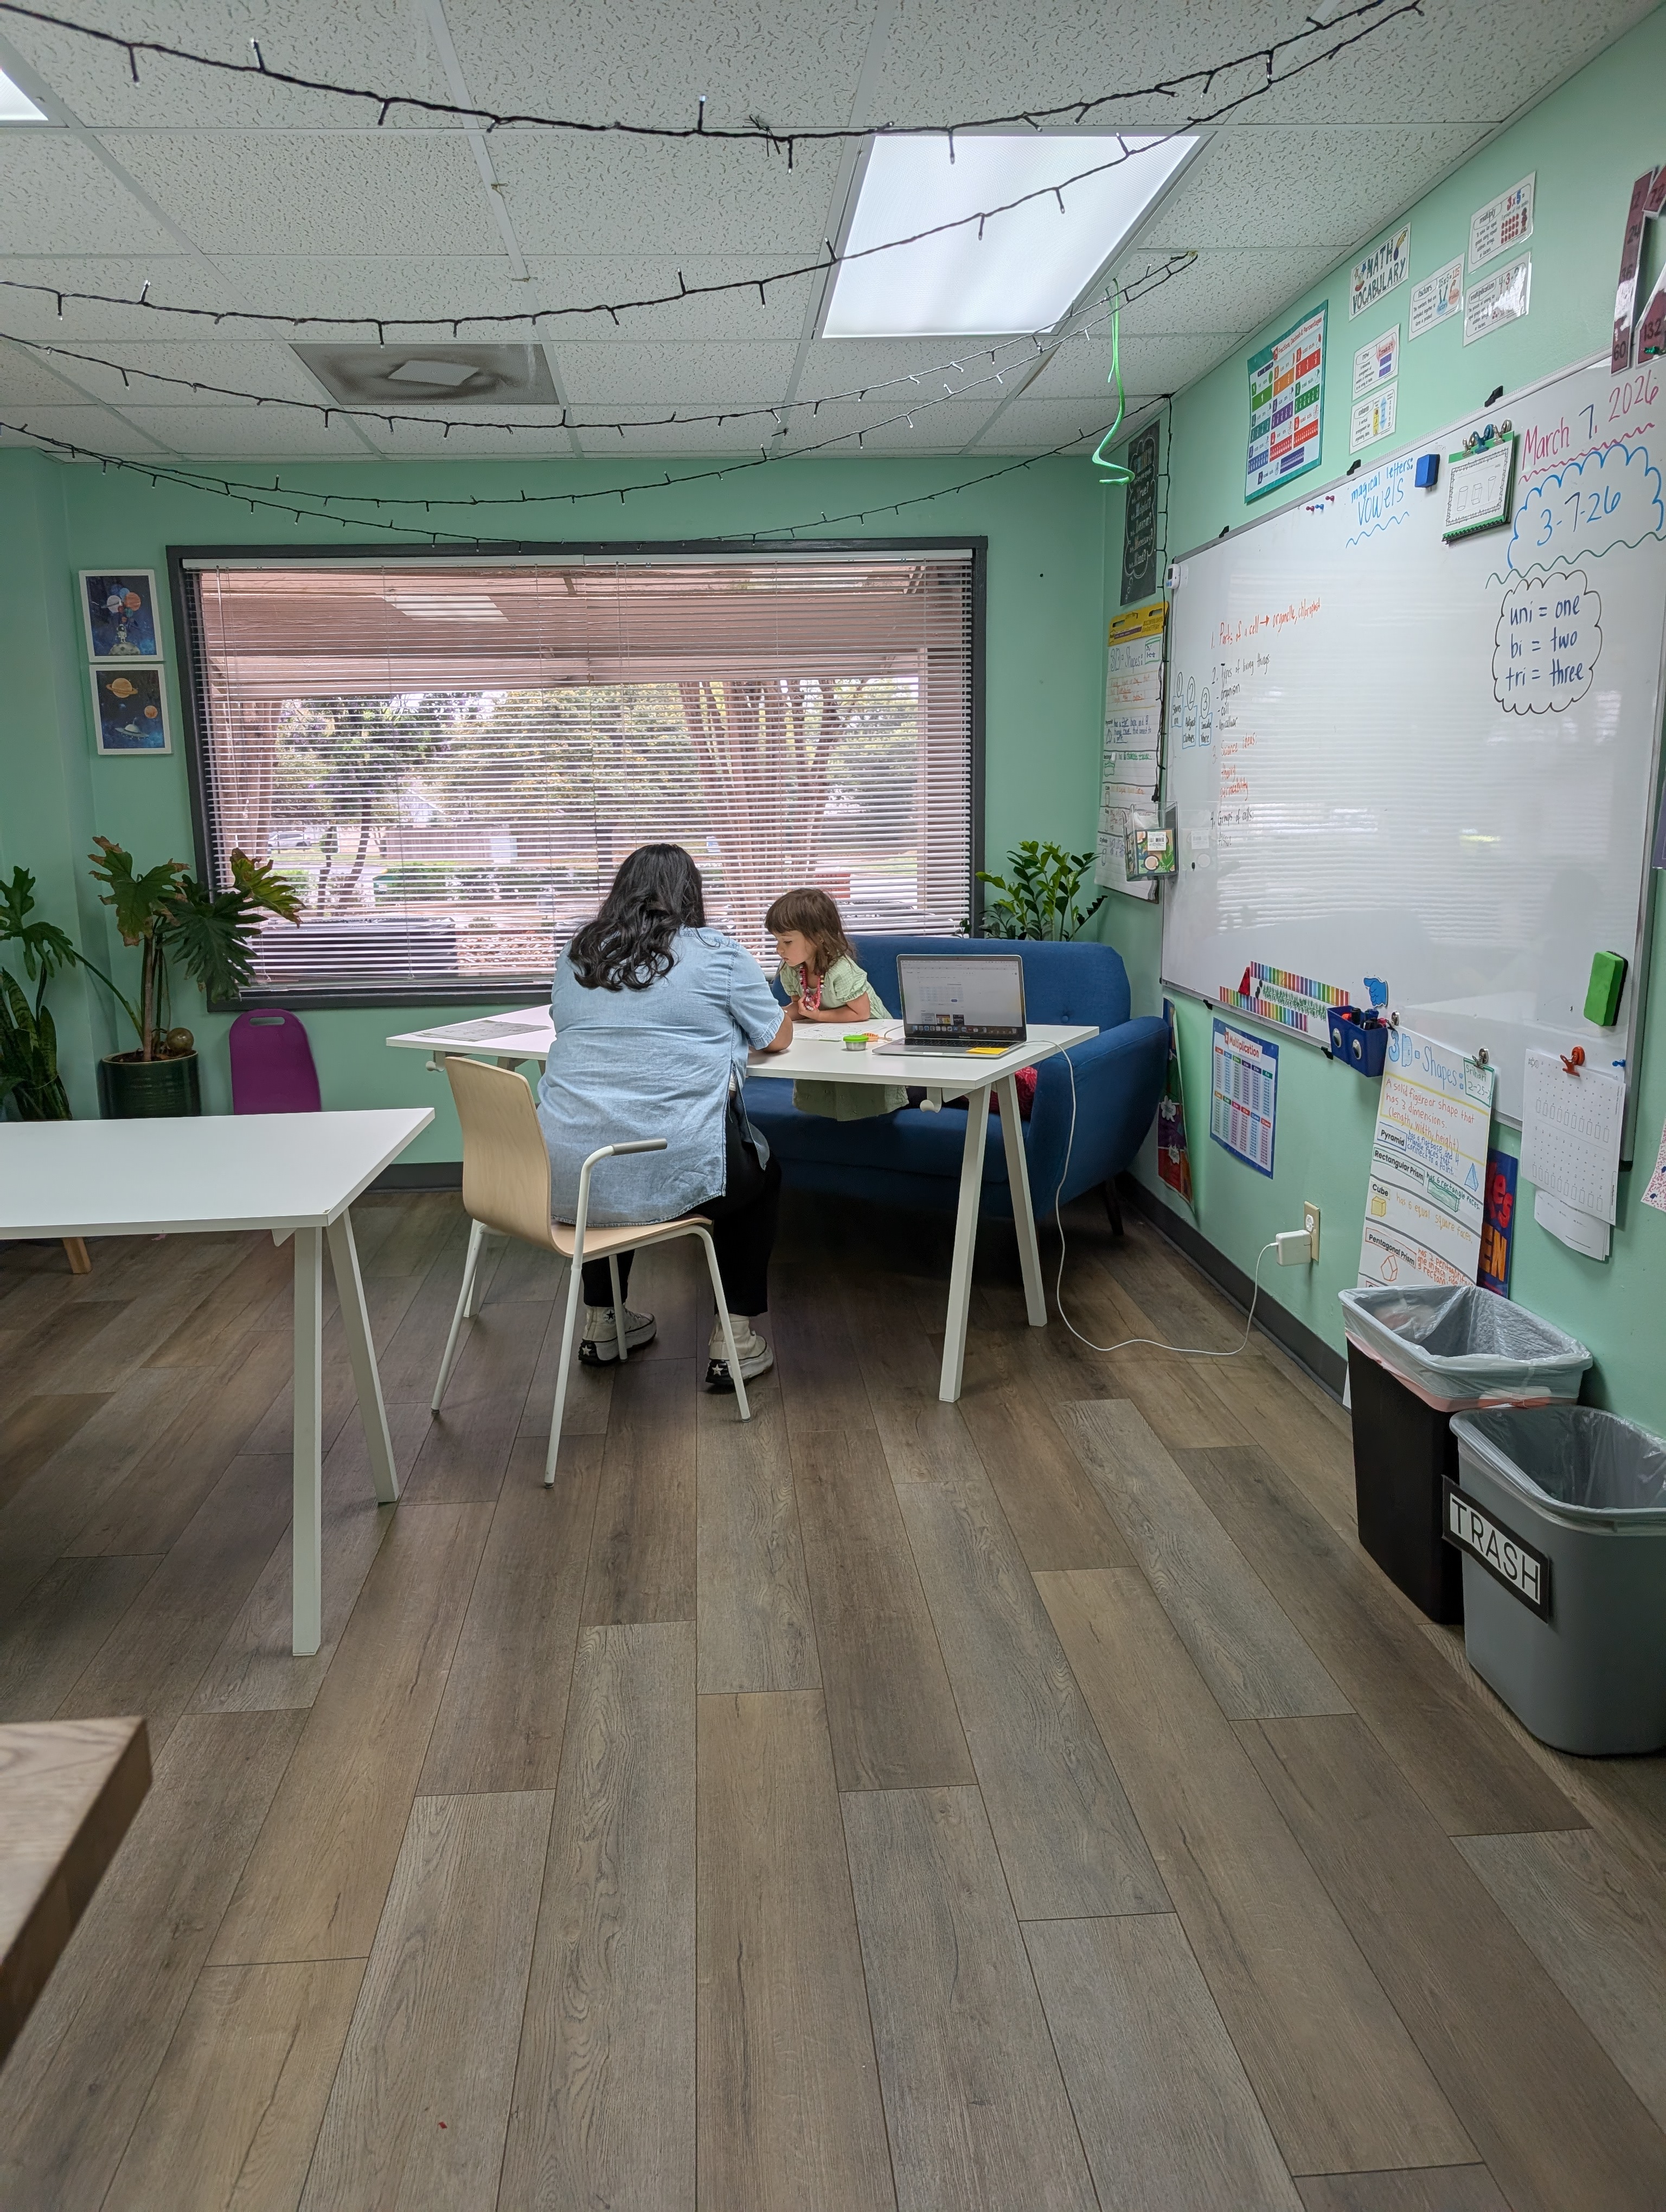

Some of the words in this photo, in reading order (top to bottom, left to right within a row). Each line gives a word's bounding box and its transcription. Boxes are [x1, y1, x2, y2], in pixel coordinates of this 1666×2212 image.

[1479, 208, 1496, 224] multiply
[1366, 237, 1393, 279] MATH
[1353, 258, 1406, 313] VOCABULARY
[1418, 284, 1432, 298] factors
[1471, 282, 1495, 301] multiplication
[1291, 331, 1300, 345] Decimals
[1304, 317, 1322, 333] Percentages
[1644, 317, 1662, 342] 132
[1614, 340, 1626, 361] 60
[1522, 416, 1569, 471] March
[1609, 369, 1659, 422] 2026
[1351, 471, 1380, 504] magical
[1387, 457, 1413, 479] letters:
[1249, 614, 1259, 635] cell
[1510, 601, 1533, 626] uni
[1539, 607, 1547, 617] =
[1555, 595, 1580, 619] one
[1511, 633, 1522, 659] bi
[1532, 640, 1541, 651] =
[1550, 627, 1578, 652] two
[1505, 667, 1526, 691] tri
[1532, 670, 1540, 679] =
[1549, 658, 1584, 687] three
[1229, 1034, 1259, 1058] Multiplication
[1388, 1030, 1413, 1067] 3D
[1422, 1046, 1463, 1090] Shapes:
[1466, 1064, 1486, 1082] Srihari
[1386, 1078, 1392, 1088] A
[1394, 1083, 1408, 1096] solid
[1438, 1099, 1458, 1118] shape
[1461, 1110, 1475, 1123] that
[1386, 1093, 1399, 1105] has
[1401, 1099, 1406, 1110] 3
[1408, 1102, 1447, 1128] dimensions.
[1381, 1129, 1405, 1147] Pyramid
[1407, 1144, 1427, 1159] connect
[1431, 1140, 1443, 1153] base
[1436, 1130, 1459, 1152] height)
[1374, 1150, 1409, 1171] Rectangular
[1410, 1166, 1424, 1181] Prism
[1372, 1184, 1389, 1197] Cube
[1427, 1172, 1435, 1181] has
[1441, 1180, 1465, 1200] rectangle
[1396, 1192, 1406, 1206] has
[1408, 1201, 1412, 1210] 6
[1414, 1205, 1430, 1219] equal
[1435, 1214, 1455, 1230] square
[1369, 1234, 1401, 1256] Pentagonal
[1401, 1251, 1415, 1265] Prism
[1418, 1248, 1427, 1257] has
[1452, 1497, 1539, 1600] TRASH
